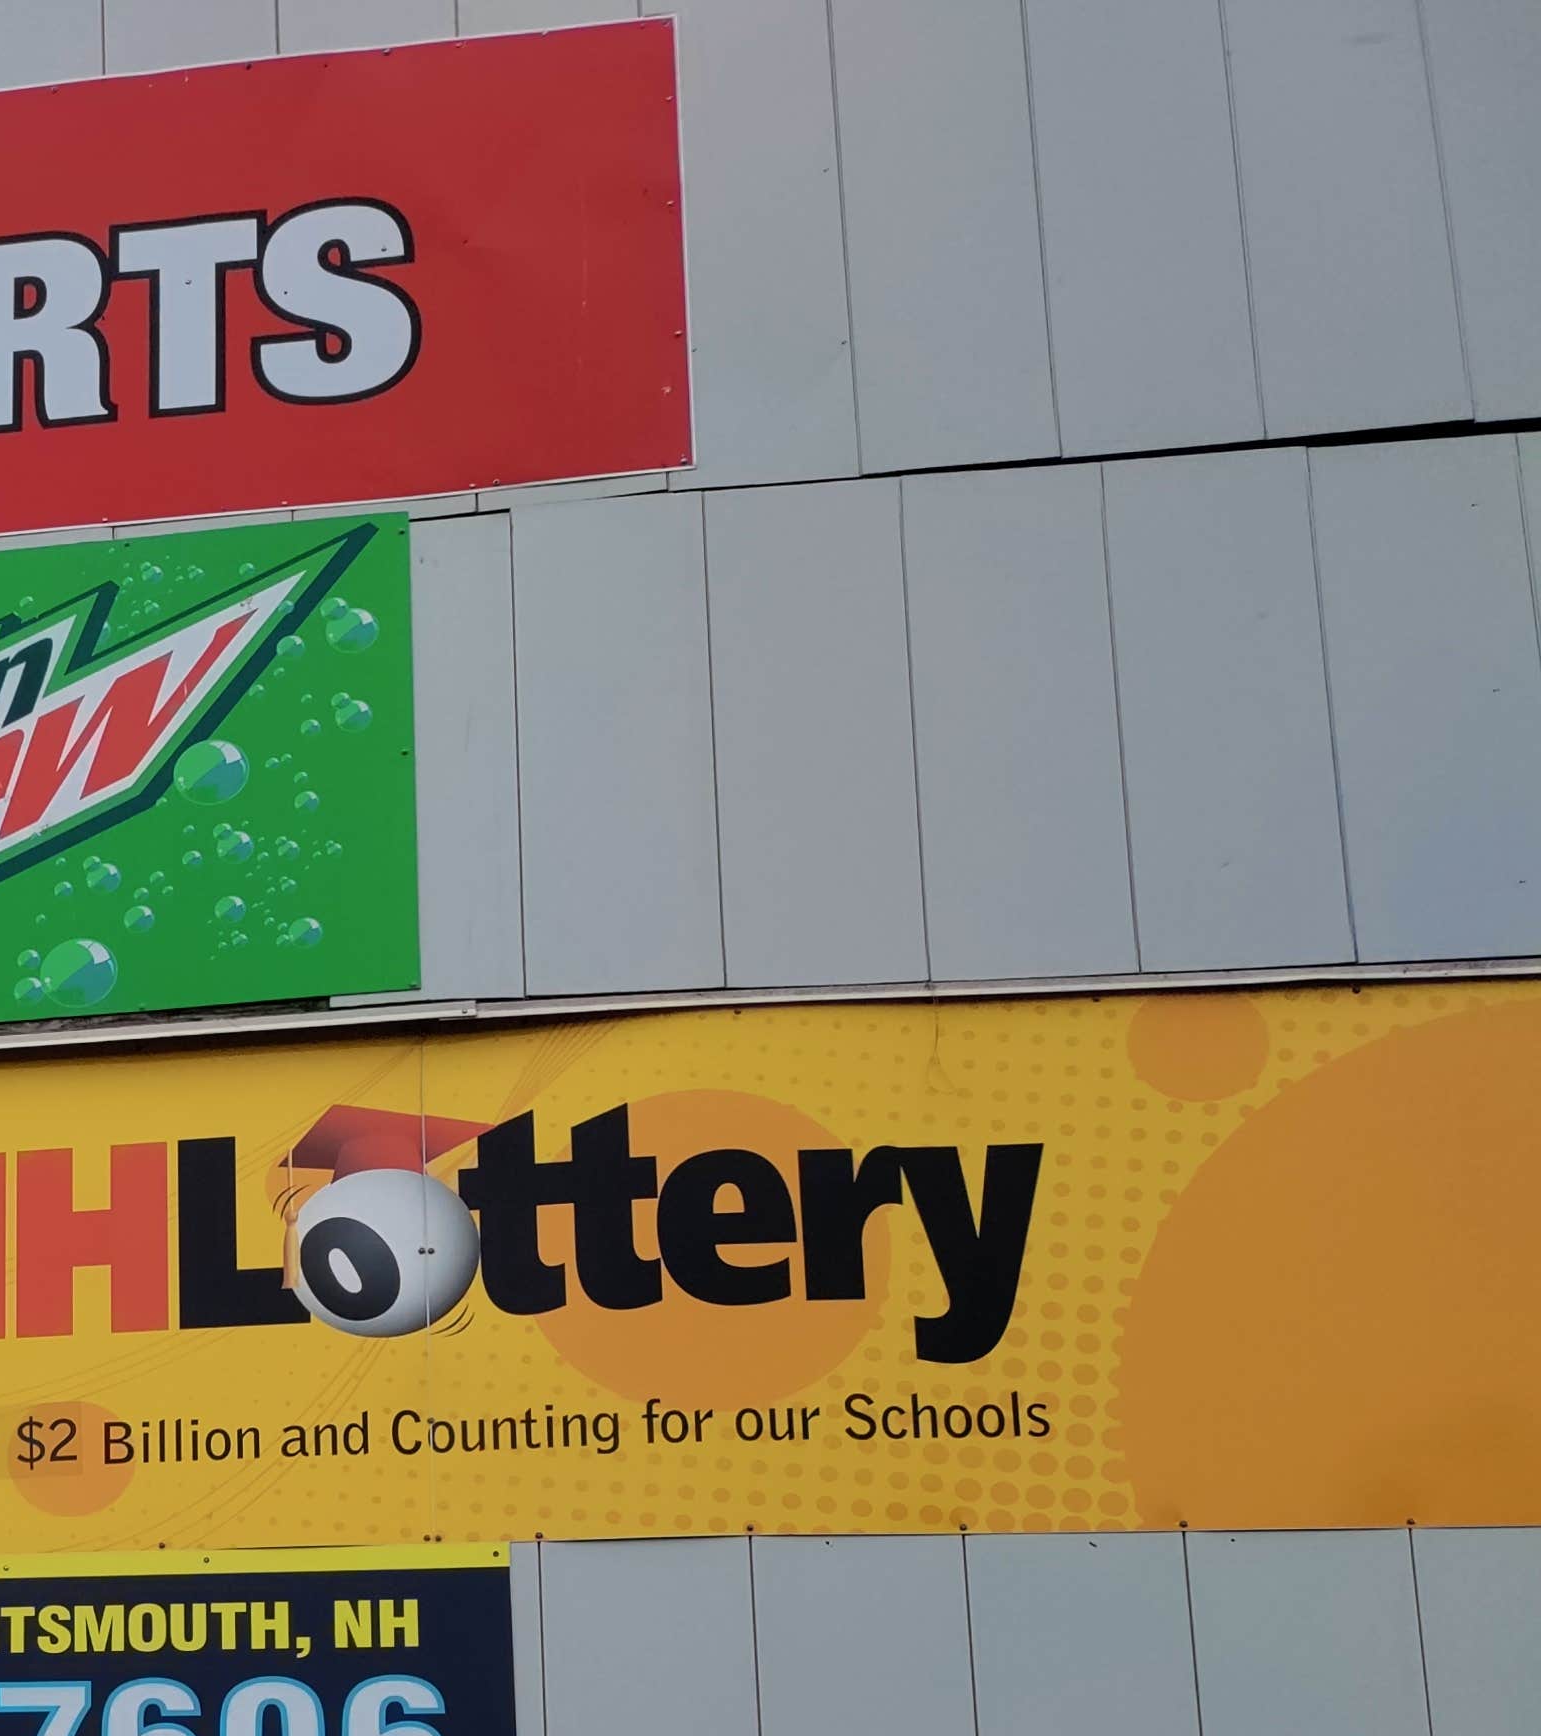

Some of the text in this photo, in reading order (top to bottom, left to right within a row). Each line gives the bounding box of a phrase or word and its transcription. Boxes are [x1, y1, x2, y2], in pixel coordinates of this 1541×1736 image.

[15, 1422, 79, 1466] $2
[101, 1413, 263, 1467] Billion
[279, 1408, 372, 1459] and
[391, 1401, 623, 1468] Counting
[642, 1395, 709, 1446] for
[733, 1404, 822, 1443] our
[842, 1392, 1052, 1440] Schools
[333, 1598, 421, 1648] NH
